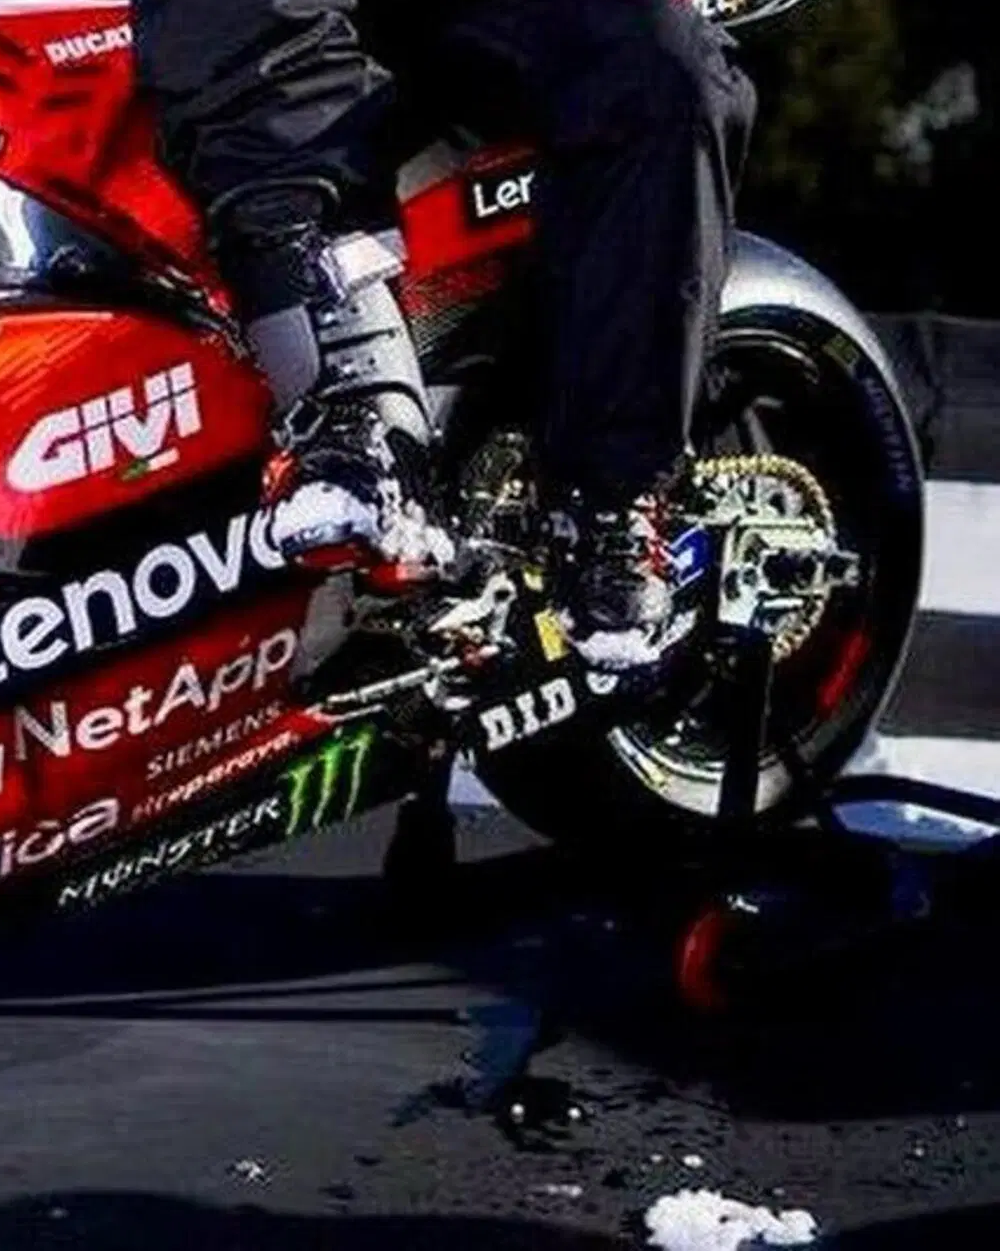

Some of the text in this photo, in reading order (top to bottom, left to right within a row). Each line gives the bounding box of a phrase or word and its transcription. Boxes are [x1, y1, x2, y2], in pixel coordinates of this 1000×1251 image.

[5, 361, 202, 494] GIVI
[14, 625, 297, 762] NetApp
[146, 700, 282, 782] SIEMENS
